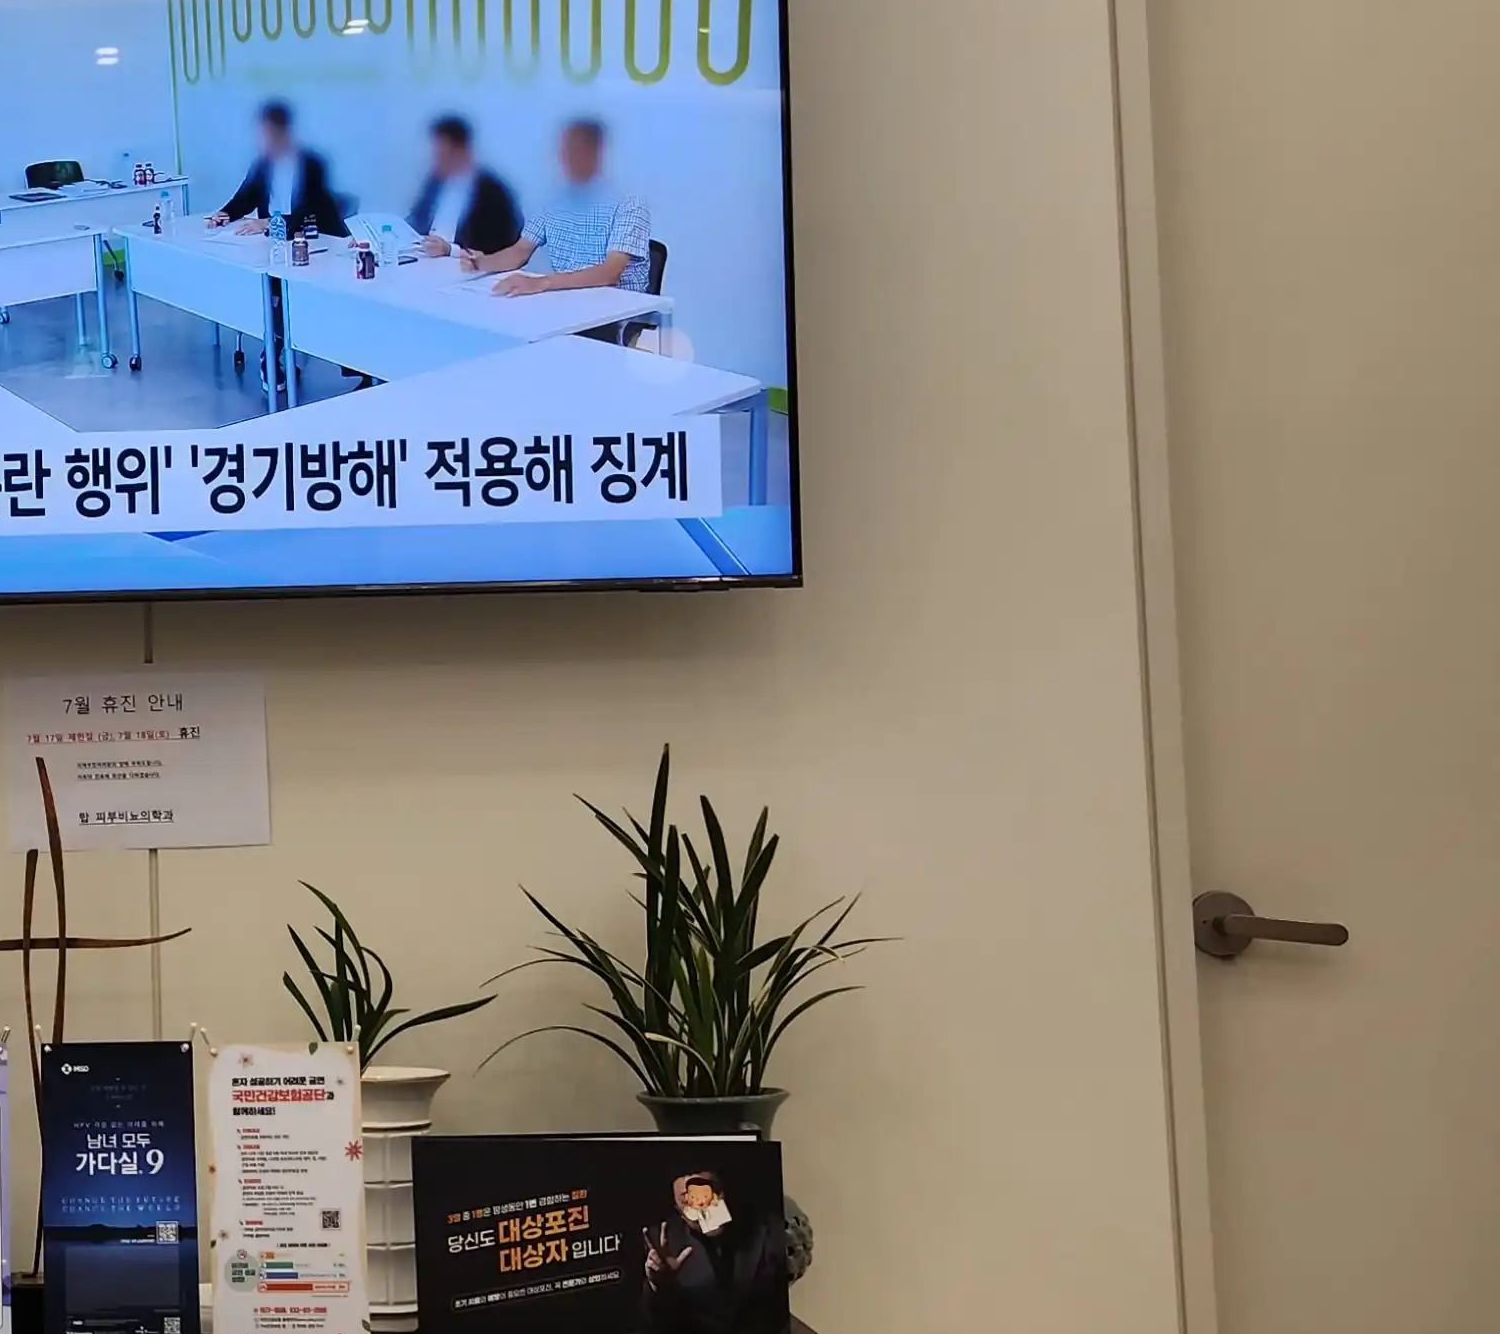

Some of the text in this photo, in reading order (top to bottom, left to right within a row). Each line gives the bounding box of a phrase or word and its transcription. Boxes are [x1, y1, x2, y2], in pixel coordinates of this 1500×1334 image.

[64, 445, 173, 518] 행위'
[190, 439, 408, 514] '경기방해'
[423, 433, 575, 508] 적용해
[589, 430, 689, 504] 징계
[62, 693, 184, 715] 7월 휴진 안내
[27, 733, 40, 744] 7월
[179, 726, 200, 739] 휴진
[95, 809, 174, 822] 피부비뇨의학과
[87, 1133, 151, 1149] 남녀 모두
[448, 1205, 590, 1254] 당신도 대상포진
[500, 1234, 620, 1273] 대상자 입니다
